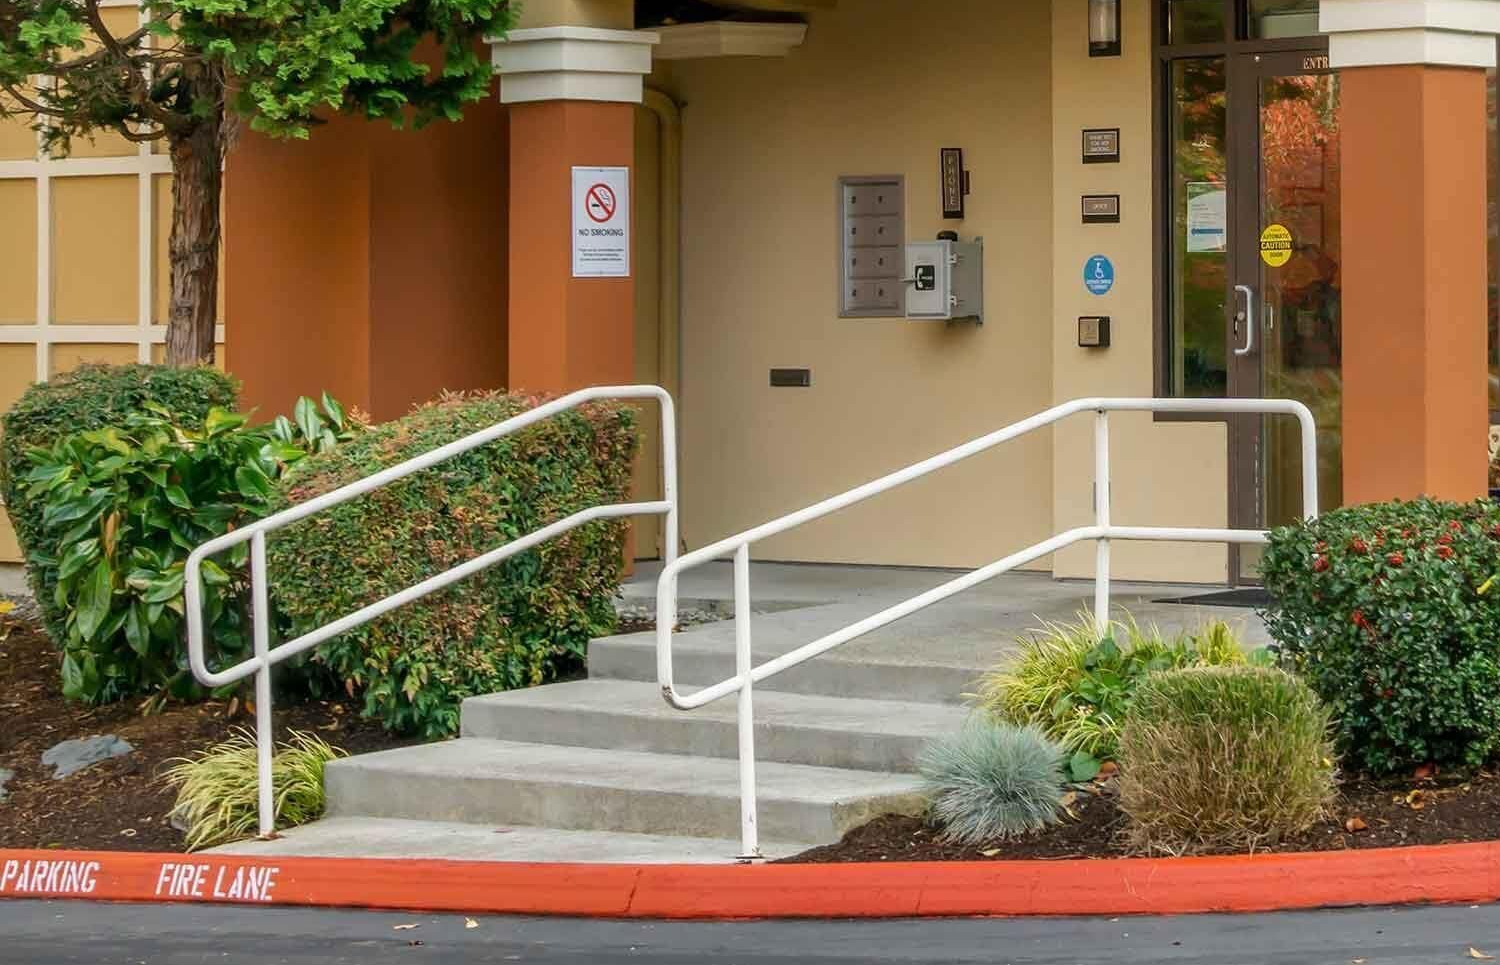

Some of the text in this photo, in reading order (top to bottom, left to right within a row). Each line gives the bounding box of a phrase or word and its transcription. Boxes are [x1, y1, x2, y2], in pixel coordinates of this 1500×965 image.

[1303, 55, 1329, 69] ENTR
[578, 228, 624, 237] NO SMOKING
[1260, 242, 1290, 250] CAUTION
[0, 859, 280, 901] PARKING FIRE LANE
